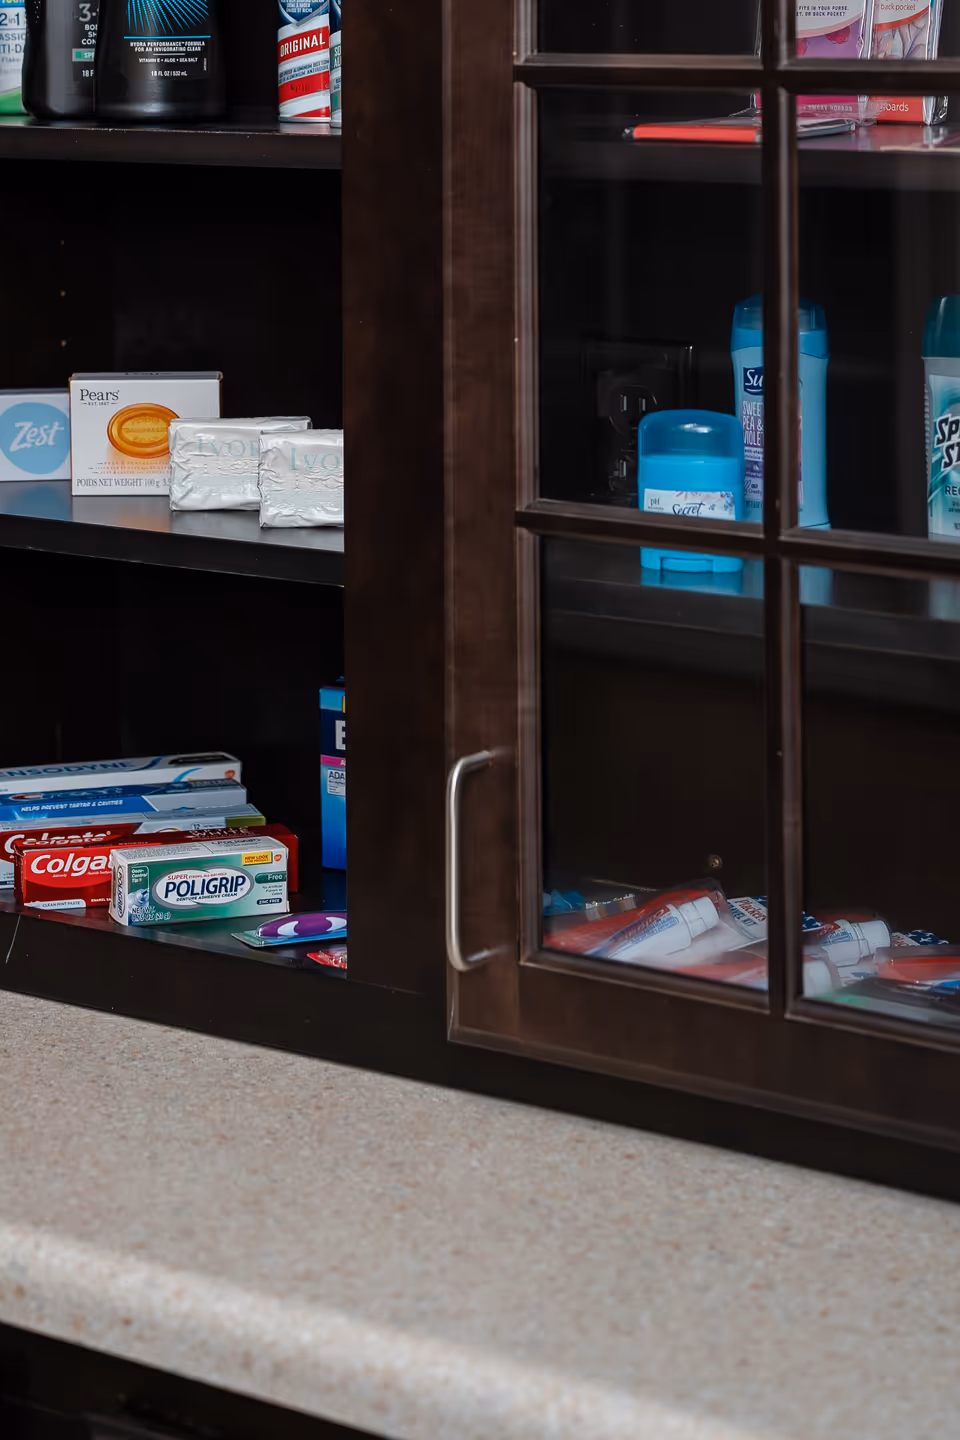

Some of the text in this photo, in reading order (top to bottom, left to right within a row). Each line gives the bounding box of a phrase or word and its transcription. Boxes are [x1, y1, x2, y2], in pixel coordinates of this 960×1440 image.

[280, 33, 326, 57] ORIGINAL
[743, 416, 763, 432] PEA &
[9, 421, 64, 452] Zest
[76, 478, 97, 487] POIDS
[99, 478, 113, 487] NET
[115, 478, 144, 487] WEIGHT
[144, 479, 155, 487] 100
[672, 502, 705, 517] Secret
[328, 771, 345, 780] ADA
[41, 803, 67, 811] PREVENT
[97, 799, 123, 807] CAVITIES
[164, 875, 246, 899] POLIGRIP
